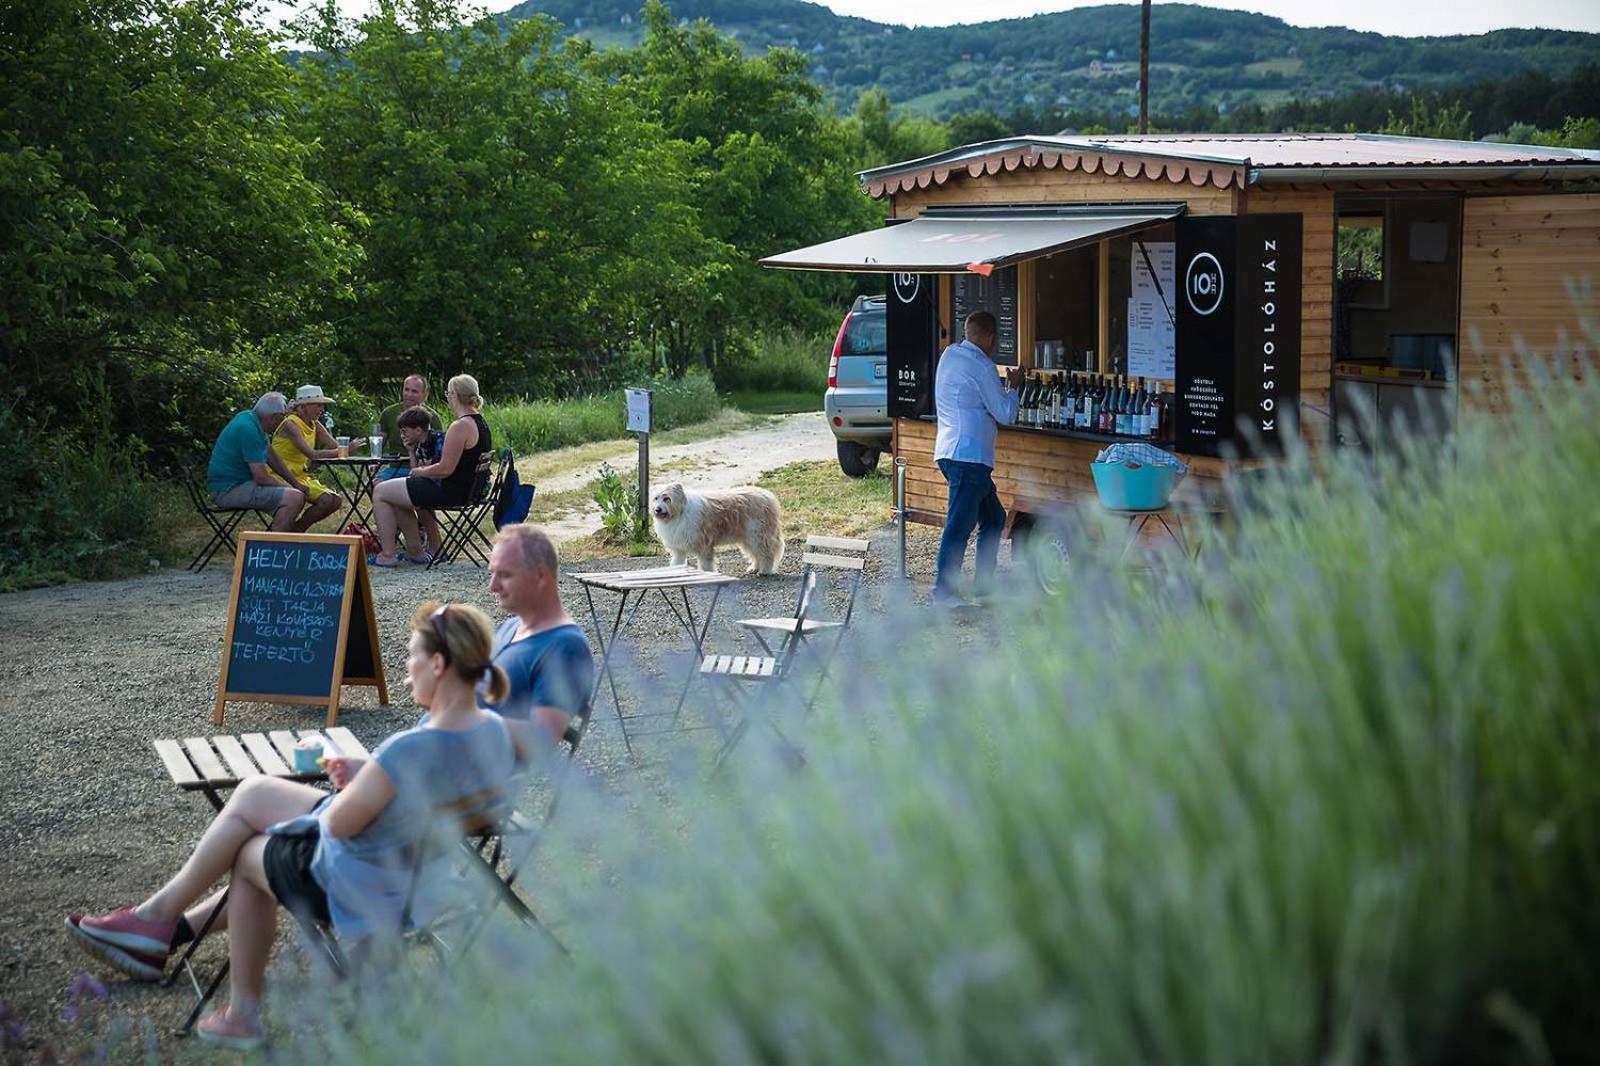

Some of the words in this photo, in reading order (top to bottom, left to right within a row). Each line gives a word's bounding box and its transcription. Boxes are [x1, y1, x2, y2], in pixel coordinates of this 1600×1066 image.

[1194, 272, 1211, 295] 10
[1260, 239, 1276, 431] KÓSTOLÓHÁZ
[898, 369, 916, 381] BOR
[247, 548, 301, 569] HELYI
[233, 641, 316, 664] TEPERTŐ
